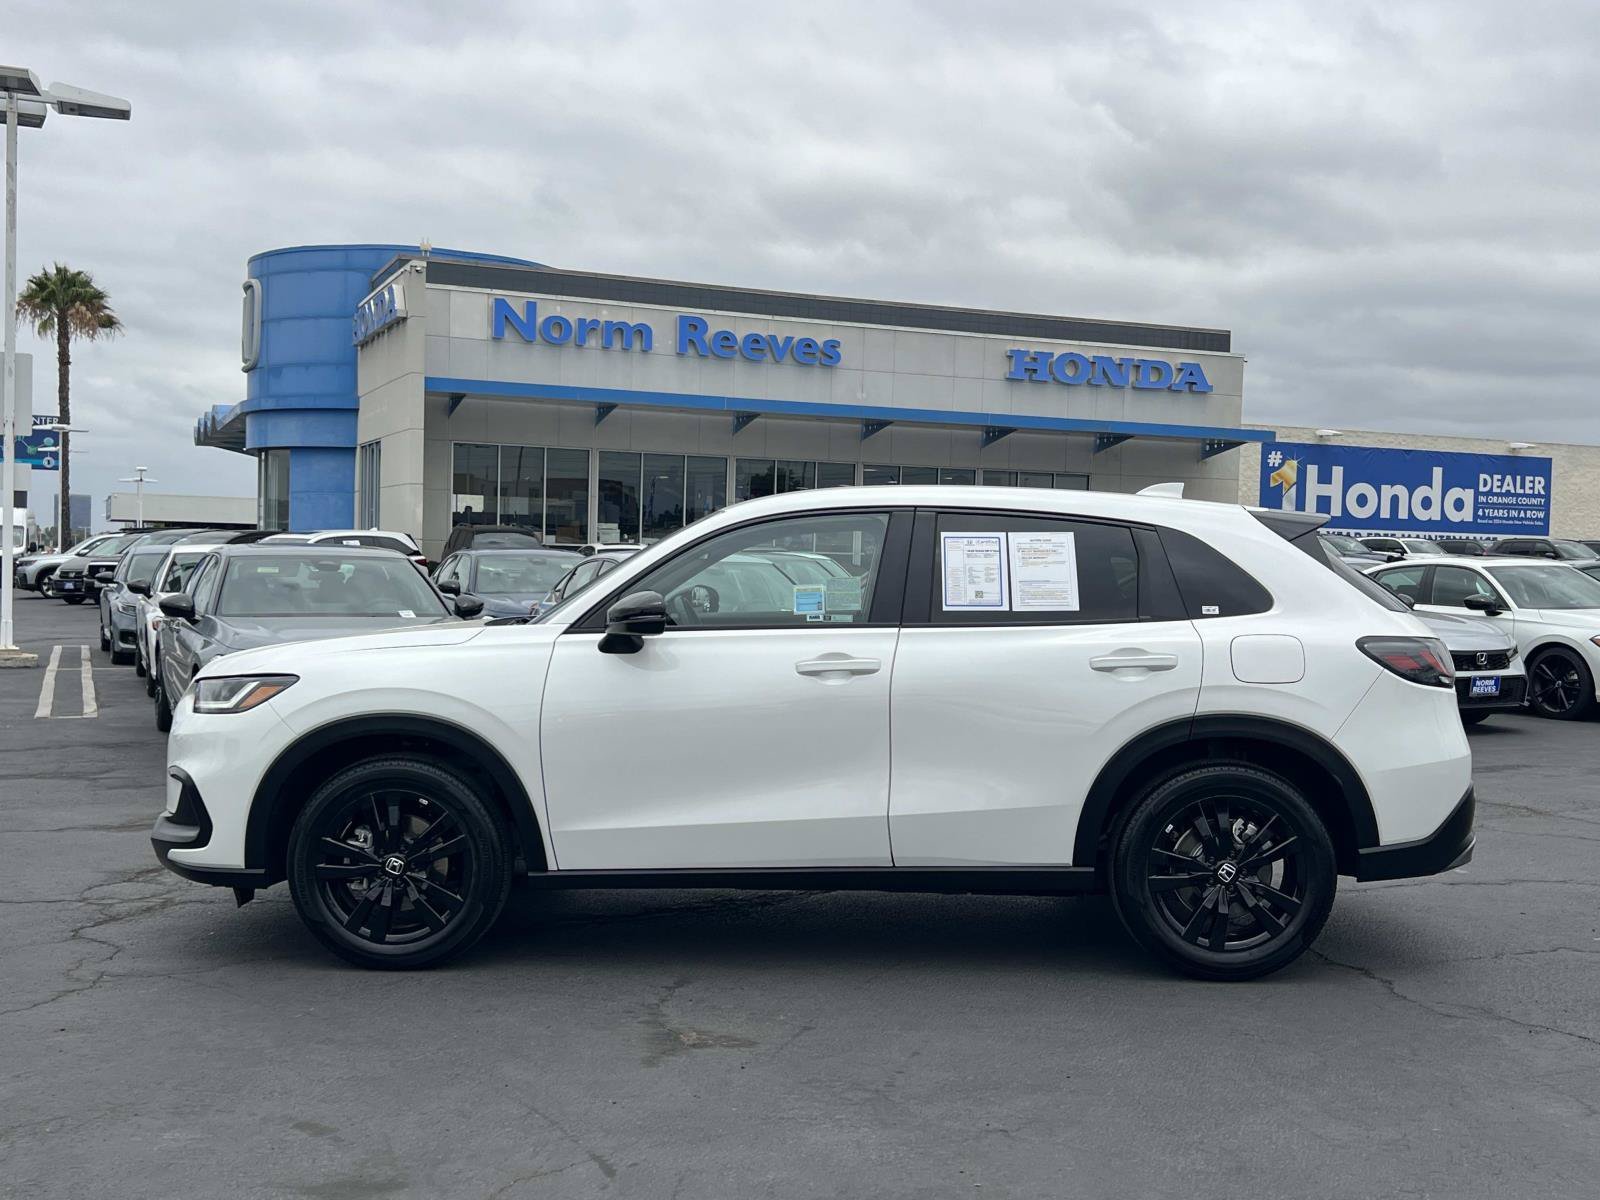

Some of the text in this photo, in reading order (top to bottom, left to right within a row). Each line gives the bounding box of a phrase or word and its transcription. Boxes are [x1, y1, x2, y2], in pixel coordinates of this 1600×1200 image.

[492, 297, 842, 367] Norm Reeves
[1005, 348, 1214, 393] HONDA
[1305, 464, 1475, 522] Honda
[1478, 473, 1546, 495] DEALER
[1478, 495, 1545, 505] IN ORANGE COUNTY
[1477, 509, 1546, 519] 4 YEARS IN A ROW
[1475, 679, 1495, 687] NORM
